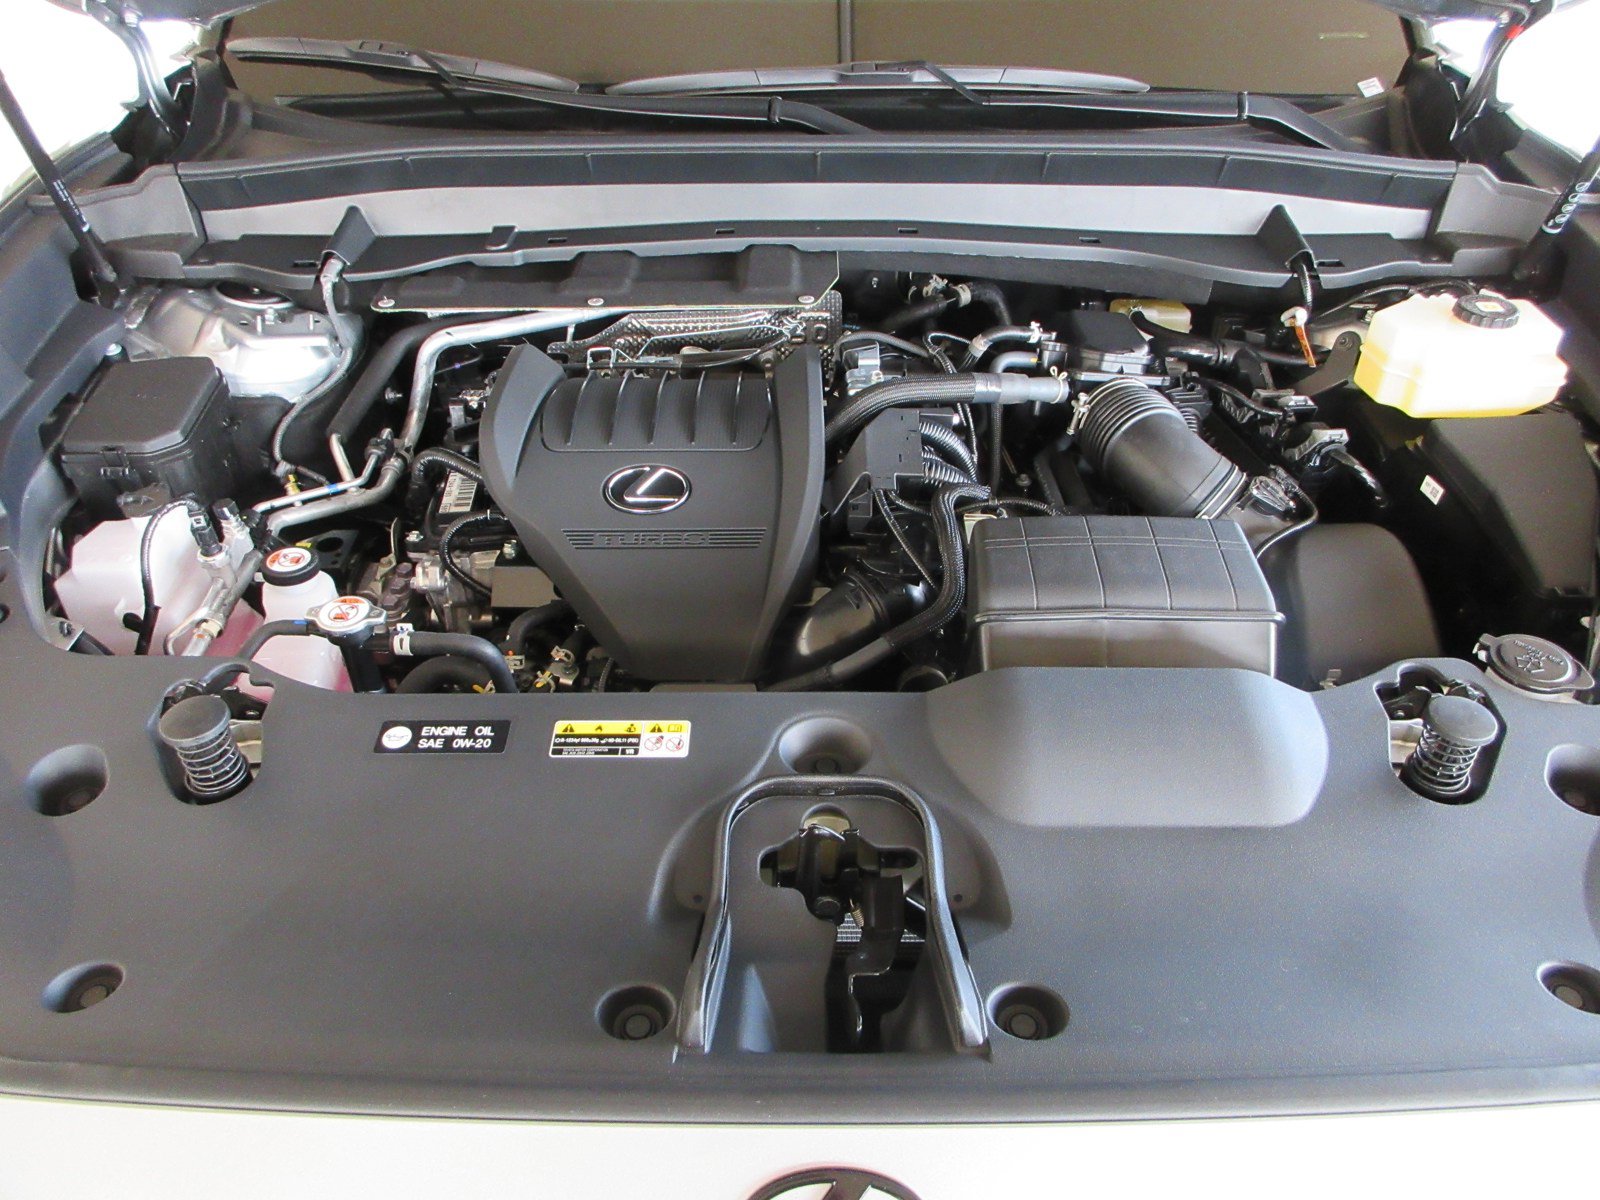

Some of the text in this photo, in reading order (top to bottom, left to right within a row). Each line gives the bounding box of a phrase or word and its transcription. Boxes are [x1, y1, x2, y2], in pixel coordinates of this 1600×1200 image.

[599, 533, 706, 546] TURBO
[421, 726, 495, 736] ENGINE OIL
[417, 738, 492, 748] SAE 0W-20
